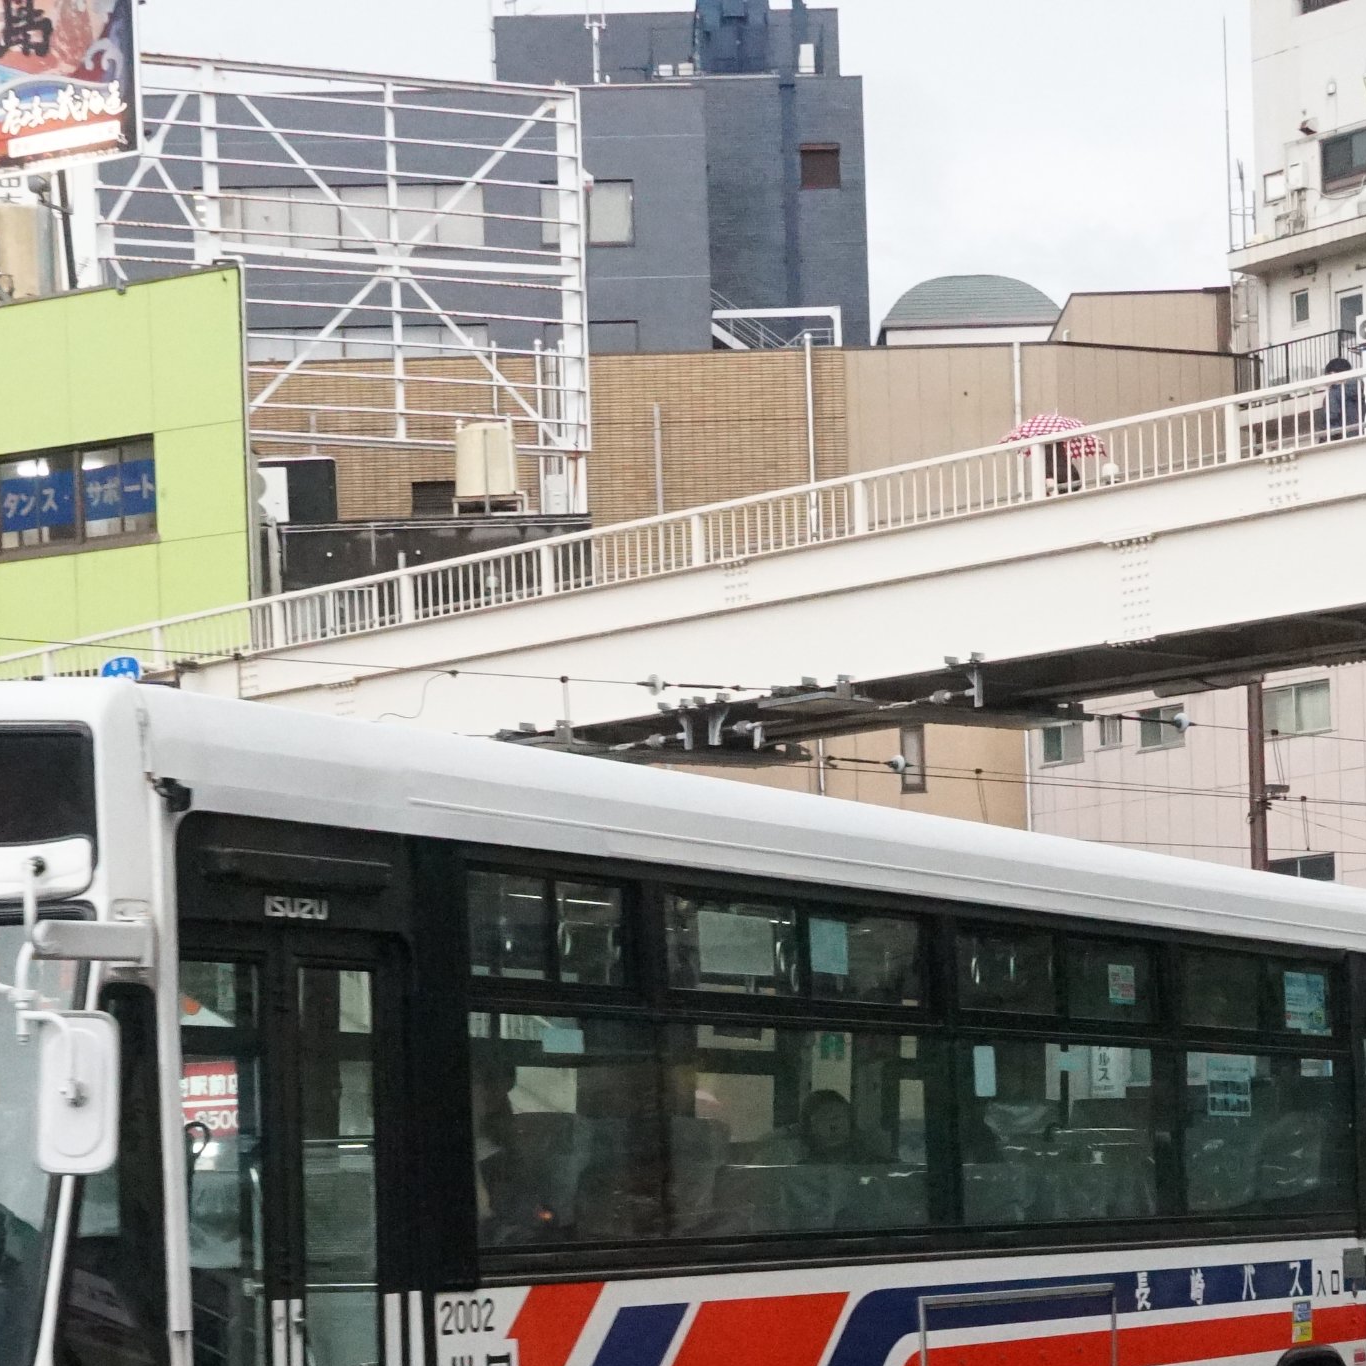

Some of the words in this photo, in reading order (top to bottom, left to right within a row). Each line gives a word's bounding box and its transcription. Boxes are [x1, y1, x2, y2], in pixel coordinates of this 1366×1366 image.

[265, 896, 328, 919] ISUZU
[1316, 1269, 1340, 1297] 入口
[440, 1298, 495, 1336] 2002
